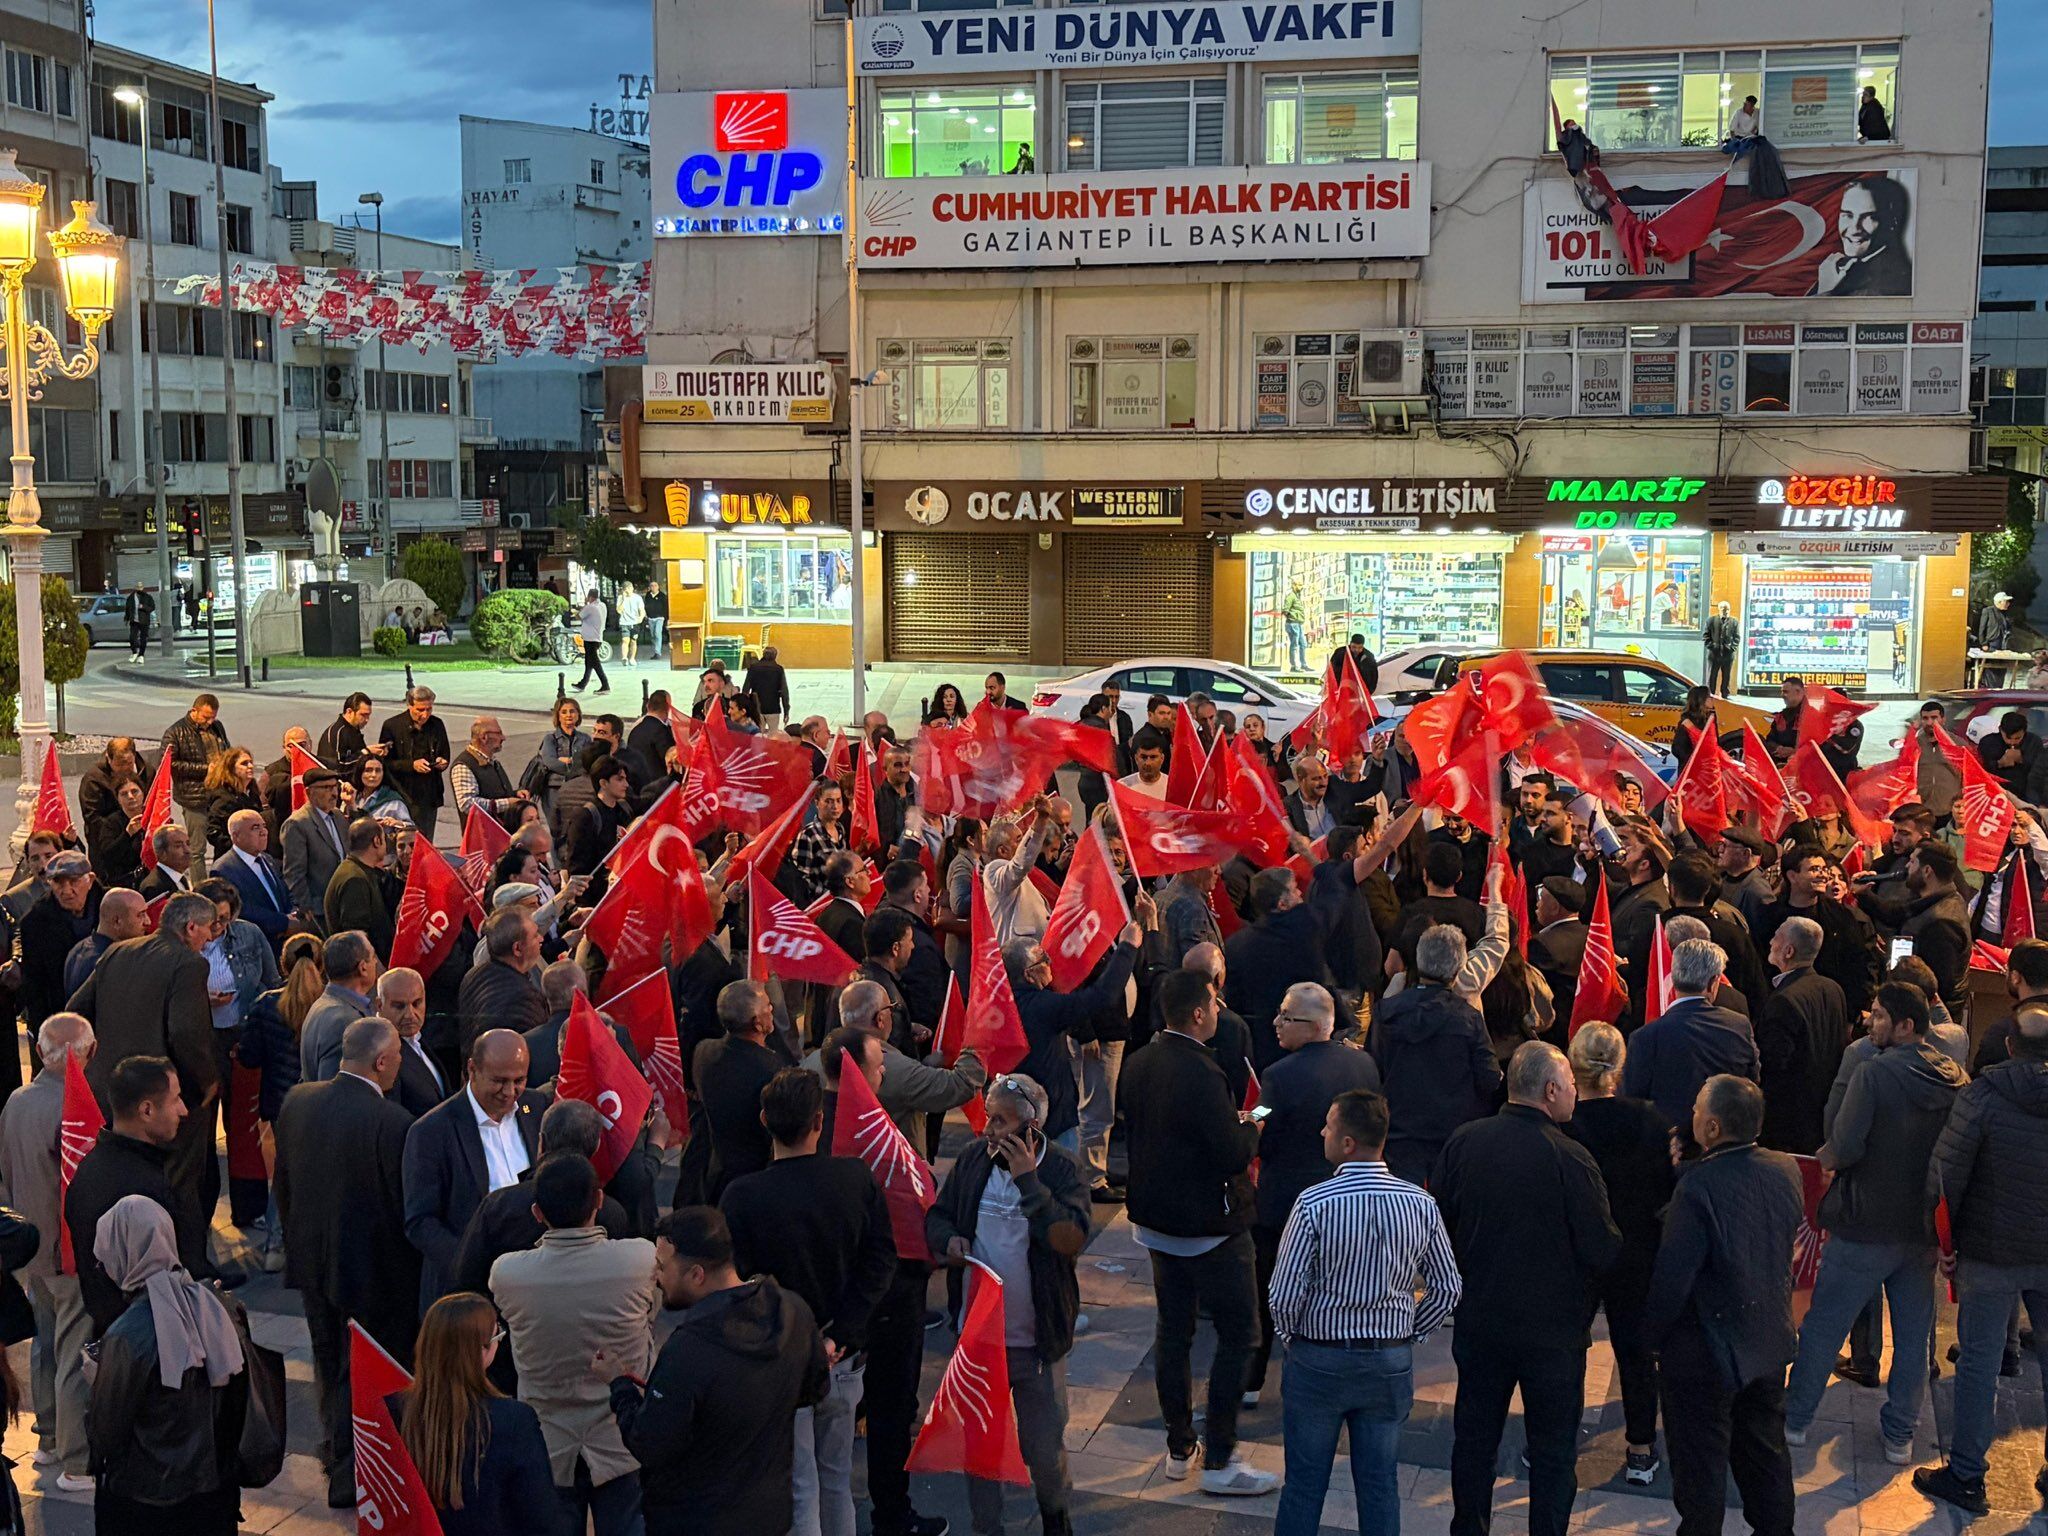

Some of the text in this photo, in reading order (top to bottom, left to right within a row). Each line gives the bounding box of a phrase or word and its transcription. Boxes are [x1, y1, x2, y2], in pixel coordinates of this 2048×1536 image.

[921, 1, 1394, 56] YENİ DÜNYA VAKFI
[1081, 52, 1101, 62] Bir
[1104, 50, 1147, 63] Dünya
[1151, 47, 1175, 60] İçin
[1793, 104, 1824, 116] CHP
[676, 152, 822, 208] CHP
[471, 189, 519, 205] HAYAT
[932, 172, 1410, 222] CUMHURİYET HALK PARTİSİ
[741, 216, 754, 232] İL
[964, 217, 1376, 252] GAZİANTEP İL BAŞKANLIĞI
[864, 236, 917, 257] CHP
[1546, 231, 1612, 261] 101.
[1564, 263, 1666, 278] KUTLU OLUN
[1748, 329, 1791, 340] LİSANS
[1857, 330, 1905, 341] ÖNLİSANS
[1917, 325, 1958, 340] ÖABT
[1135, 342, 1160, 351] HOCAM
[1263, 364, 1283, 372] KPSS
[677, 371, 769, 397] MUSTAFA
[1583, 378, 1618, 389] BENİM
[1701, 352, 1711, 412] KPSS
[1720, 353, 1735, 412] DGS
[1862, 374, 1898, 386] BENİM
[892, 370, 900, 425] KPSS
[991, 370, 1002, 424] ÖABT
[1580, 391, 1621, 402] HOCAM
[1858, 388, 1901, 399] HOCAM
[680, 405, 695, 417] 25
[1078, 491, 1160, 504] WESTERN
[1547, 477, 1707, 502] MAARİF
[1786, 475, 1896, 507] ÖZGÜR
[967, 491, 1065, 522] OCAK
[1276, 480, 1496, 520] ÇENGEL İLETİŞİM
[1103, 503, 1160, 515] UNION
[1319, 519, 1358, 528] AKSESUAR
[1364, 518, 1391, 528] TEKNİK
[1392, 518, 1417, 528] SERVİS
[1780, 505, 1906, 531] İLETİŞİM
[1799, 540, 1841, 555] ÖZGÜR
[1843, 540, 1894, 554] İLETİŞİM
[1771, 672, 1781, 684] EL
[1802, 672, 1844, 685] TELEFONU
[757, 930, 824, 960] CHP
